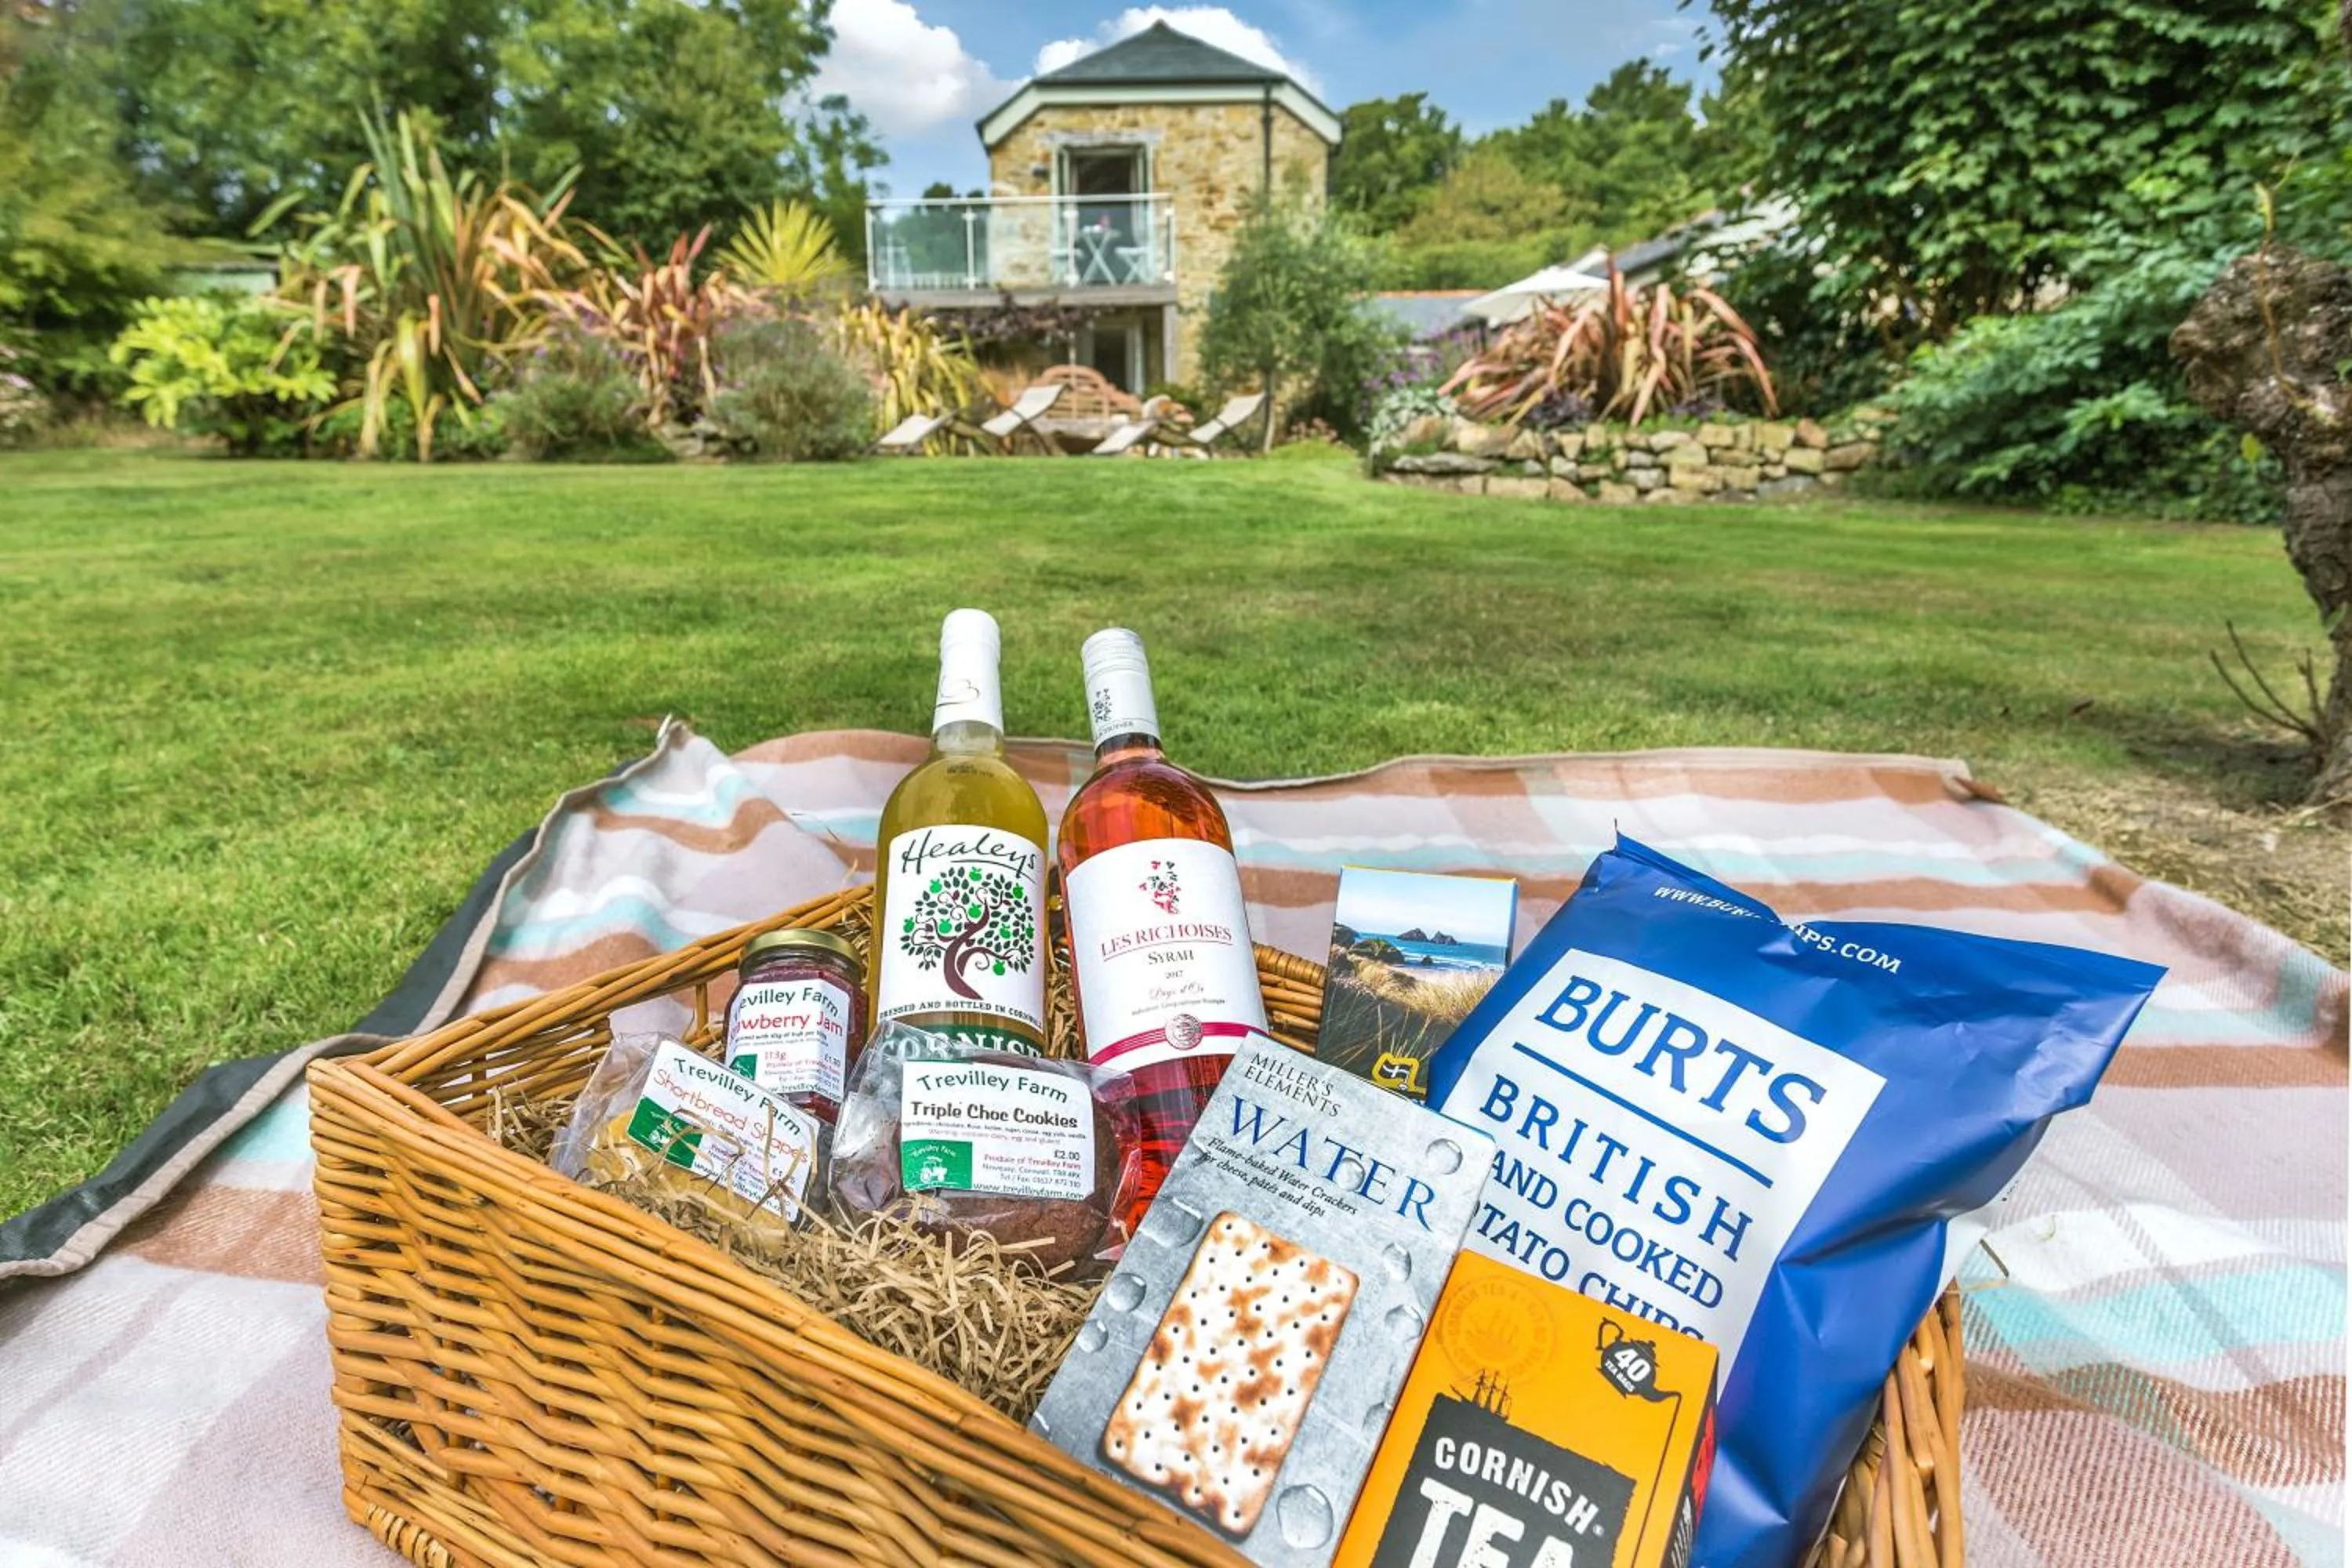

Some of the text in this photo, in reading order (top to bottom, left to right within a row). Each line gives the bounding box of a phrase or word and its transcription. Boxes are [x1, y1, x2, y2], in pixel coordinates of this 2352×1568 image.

[901, 829, 1036, 879] Healeys
[1101, 923, 1232, 957] LES RICHOISES
[1148, 949, 1195, 965] SYRAH
[802, 987, 839, 1017] Farm
[816, 1011, 844, 1037] Jam
[919, 1000, 941, 1011] AND
[946, 1000, 992, 1011] BOTTLED
[1250, 1052, 1334, 1097] MILLER'S
[1534, 975, 1828, 1145] BURTS
[653, 1069, 749, 1132] Shortbread
[673, 1057, 802, 1137] Trevilley Farm
[916, 1070, 1068, 1104] Trevilley Farm
[1243, 1065, 1341, 1117] ELEMENTS
[911, 1101, 1078, 1129] Triple Choc Cookies
[1054, 1149, 1080, 1161] £2.00
[1207, 1137, 1359, 1215] Flame-baked Water Crackers
[1231, 1094, 1436, 1232] WATER
[1479, 1073, 1754, 1263] BRITISH
[1193, 1150, 1217, 1167] for
[1279, 1190, 1305, 1207] and
[1301, 1199, 1327, 1218] dips
[1473, 1199, 1571, 1280] TATO
[1492, 1150, 1725, 1310] AND COOKED
[1605, 1359, 1635, 1393] TEA BAGS
[1613, 1348, 1651, 1382] 40
[1434, 1436, 1600, 1536] CORNISH
[1408, 1476, 1574, 1568] TE
